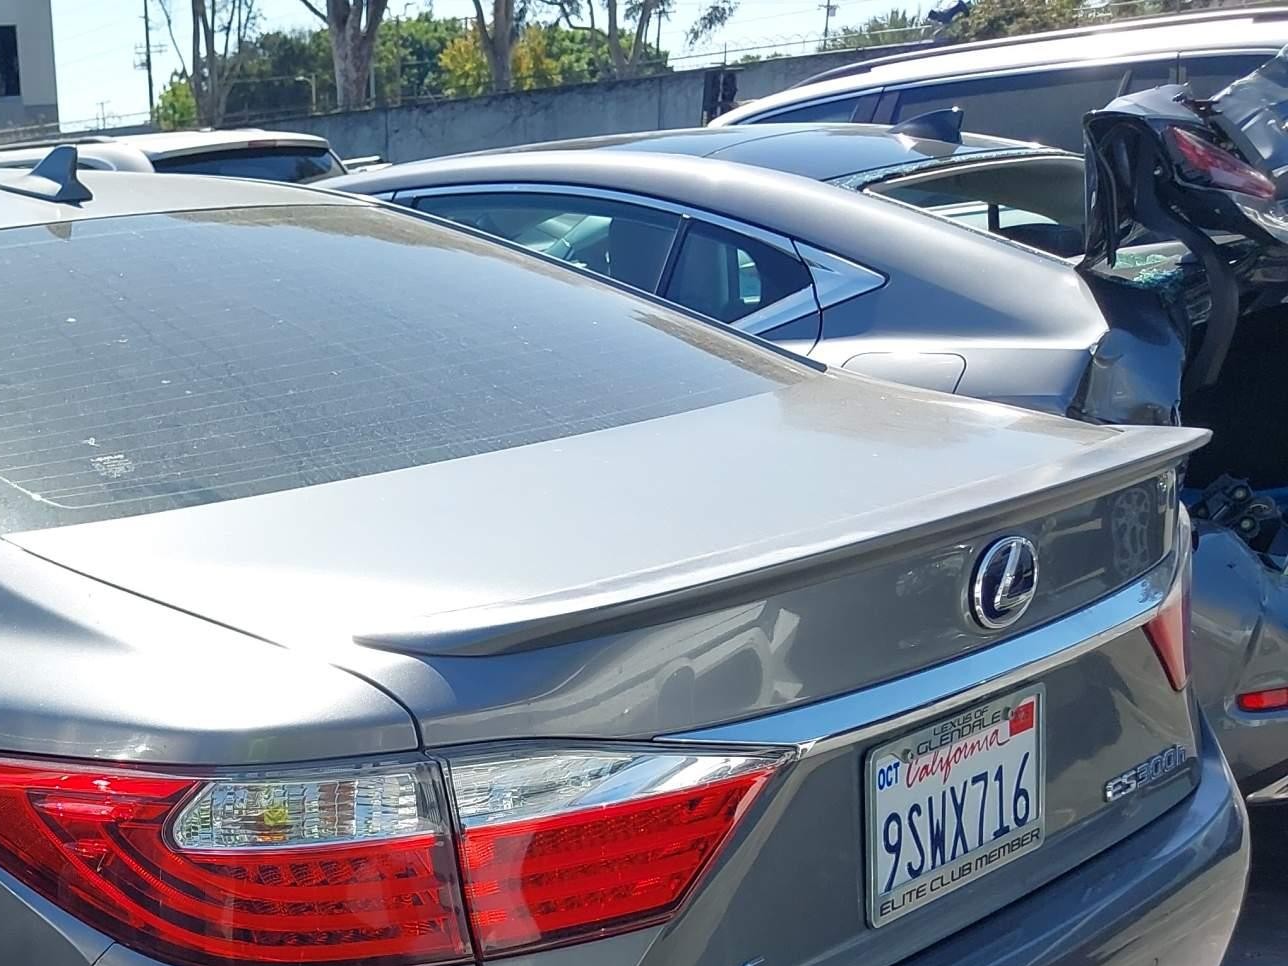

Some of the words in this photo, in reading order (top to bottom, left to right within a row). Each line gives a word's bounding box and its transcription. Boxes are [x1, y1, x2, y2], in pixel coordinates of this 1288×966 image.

[917, 710, 1002, 756] GLENDALE
[933, 712, 972, 737] LEXUS
[972, 706, 989, 722] OF
[878, 762, 901, 790] OCT
[905, 729, 1010, 788] California
[883, 752, 1031, 895] 9SWX716
[880, 884, 928, 917] ELITE
[930, 862, 973, 893] CLUB
[974, 828, 1041, 870] MEMBER
